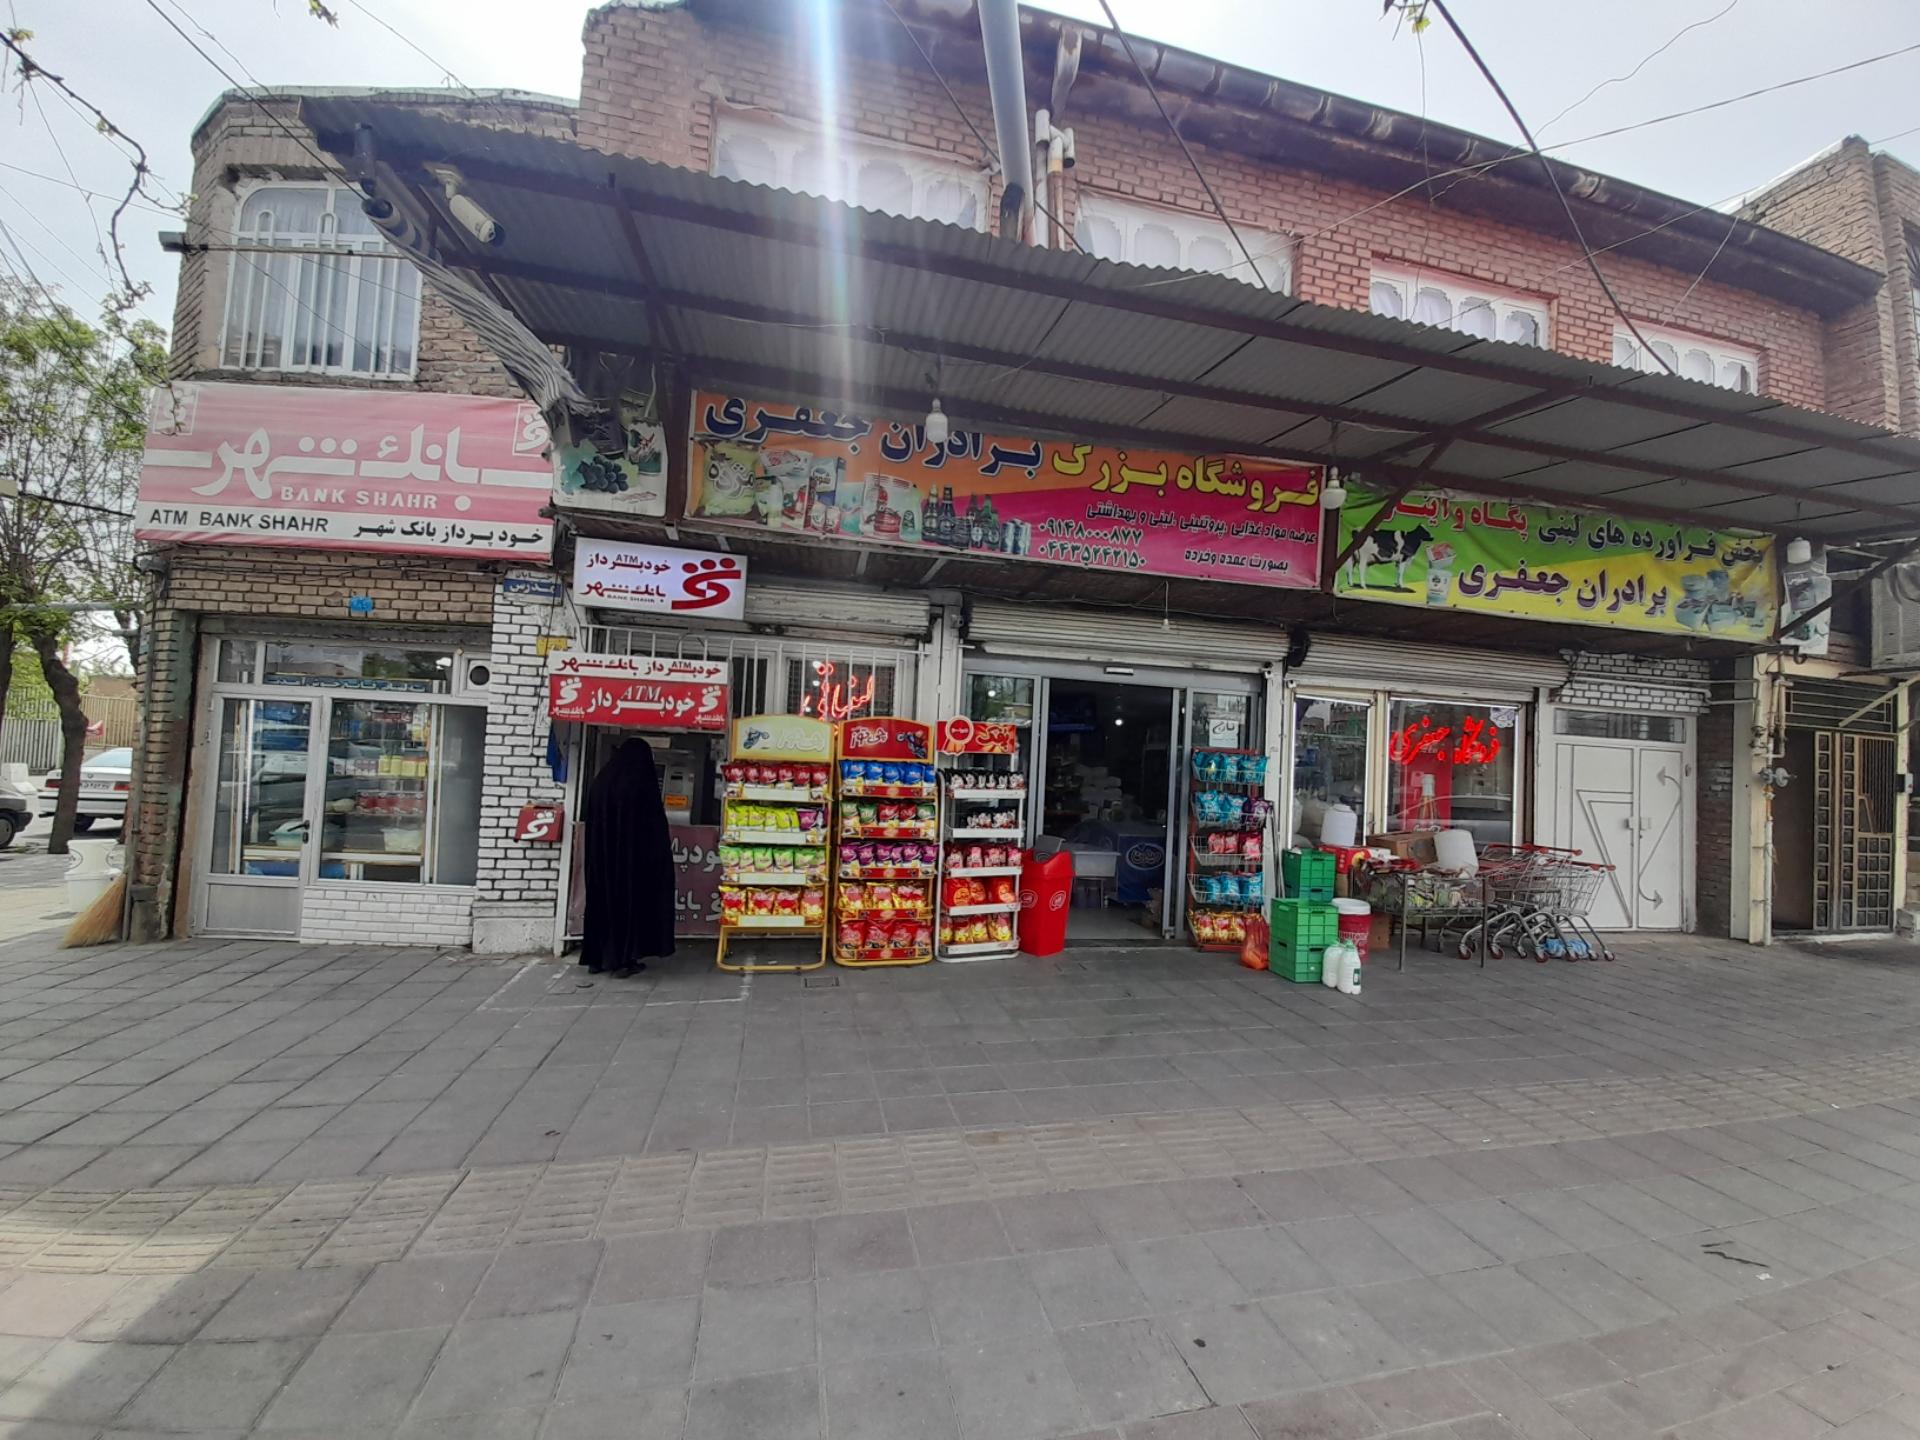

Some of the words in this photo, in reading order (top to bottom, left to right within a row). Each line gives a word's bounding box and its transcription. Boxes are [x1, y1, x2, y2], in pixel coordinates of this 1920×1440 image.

[704, 397, 873, 456] جعفری
[879, 421, 1044, 481] برادران
[190, 427, 356, 500] شهر
[1051, 441, 1169, 498] بزرگ
[1175, 455, 1321, 513] فروشگاه
[280, 485, 346, 504] BANK
[355, 489, 438, 510] SHAHR
[149, 508, 188, 526] ATM
[199, 510, 254, 529] BANK
[258, 514, 330, 533] SHAHR
[353, 519, 396, 538] شهر
[400, 520, 437, 542] بانک
[1470, 500, 1529, 543] پگاه
[1537, 514, 1582, 545] لبنی
[1263, 522, 1288, 542] مواد
[615, 553, 640, 564] ATM
[1218, 551, 1248, 568] عمده
[1248, 555, 1289, 574] بصورت
[579, 580, 630, 598] شهر
[630, 583, 667, 603] بانک
[1457, 558, 1571, 607] جعفری
[1576, 567, 1669, 618] برادران
[555, 656, 604, 673] شهر
[604, 657, 639, 676] بانک
[671, 660, 693, 670] ATM
[619, 684, 663, 702] ATM
